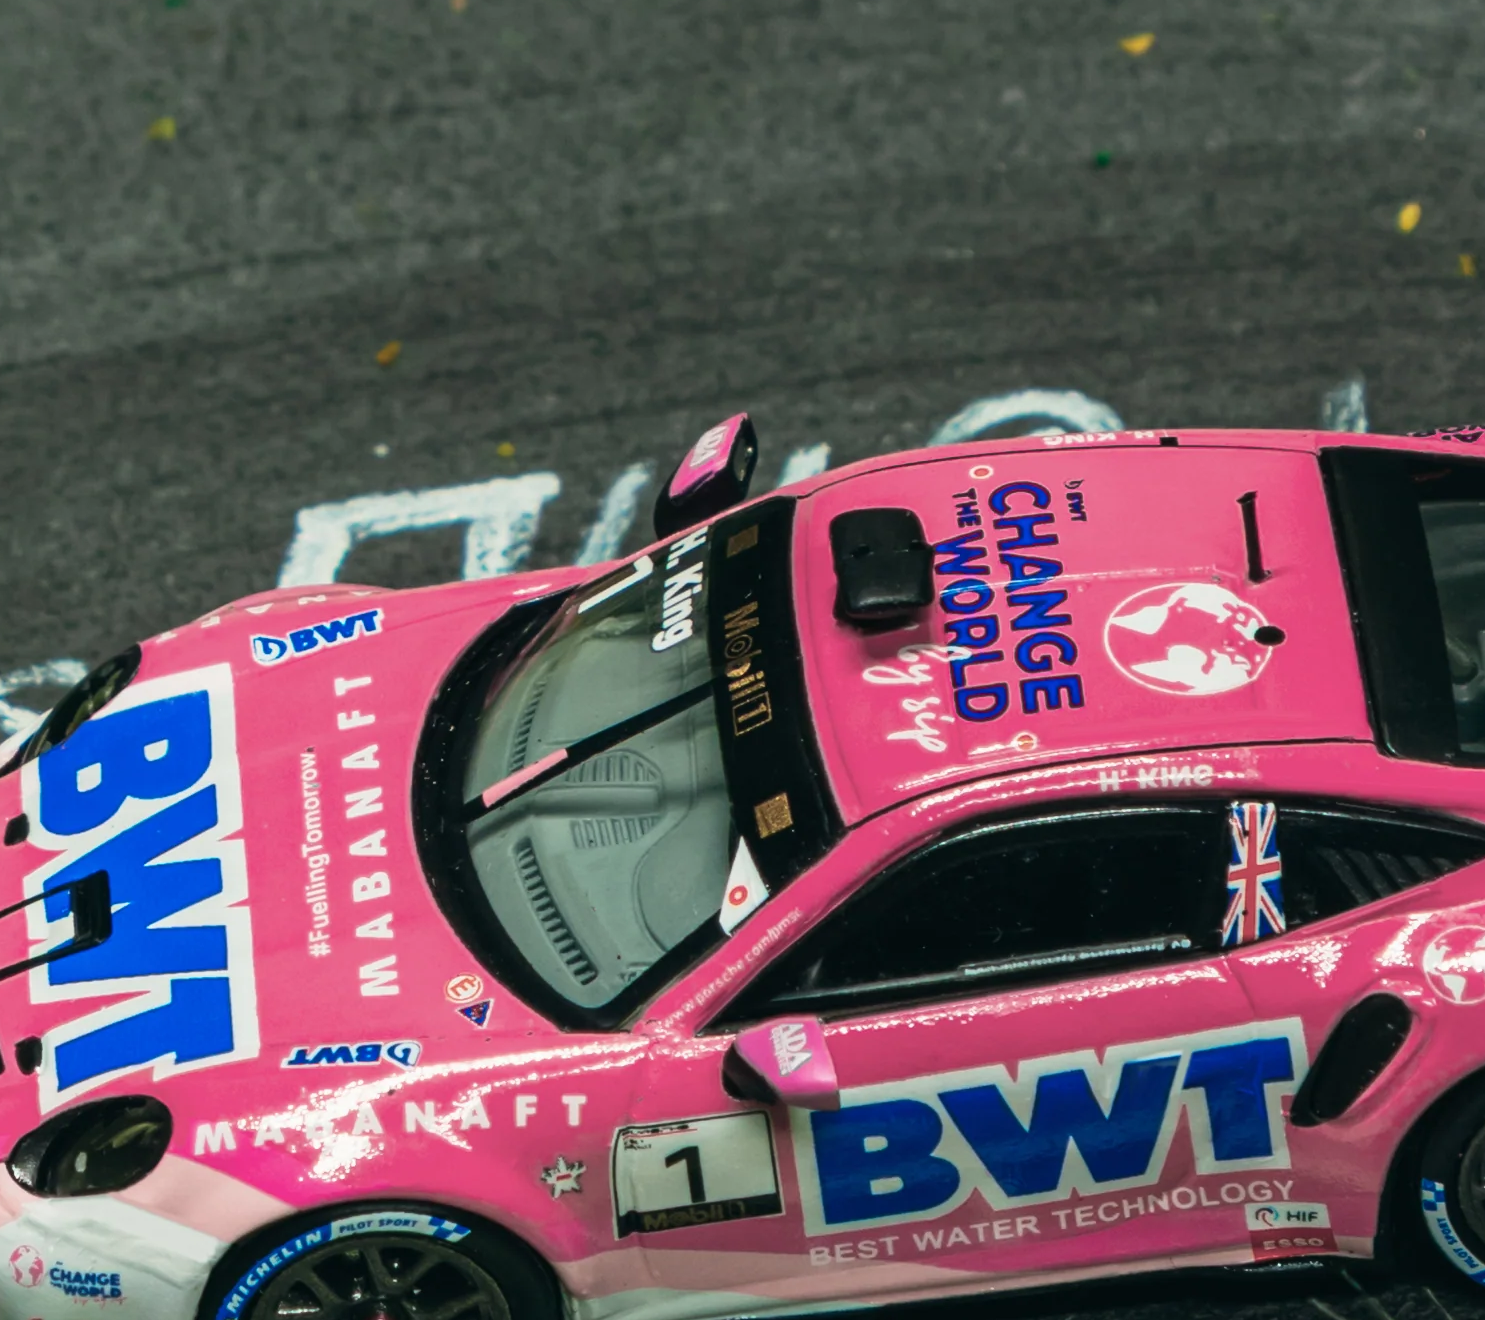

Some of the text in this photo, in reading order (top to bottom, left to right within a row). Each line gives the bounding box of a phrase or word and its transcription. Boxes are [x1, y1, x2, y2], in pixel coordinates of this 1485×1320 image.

[287, 608, 381, 656] BWT
[651, 561, 706, 653] King
[932, 487, 1011, 723] THE WORLD
[988, 480, 1086, 715] CHANGE
[334, 674, 402, 998] MABANAFT
[38, 689, 239, 1094] BWT
[288, 1043, 381, 1066] BWT
[664, 1145, 707, 1204] 1
[810, 1036, 1295, 1226] BWT
[808, 1179, 1295, 1268] BEST WATER TECHNOLOGY
[1262, 1236, 1325, 1251] ESSO
[1286, 1210, 1319, 1223] HIF
[48, 1267, 122, 1287] CHANGE
[62, 1284, 124, 1300] WORLD
[226, 1217, 419, 1314] MICHELIN PILOT SPORT
